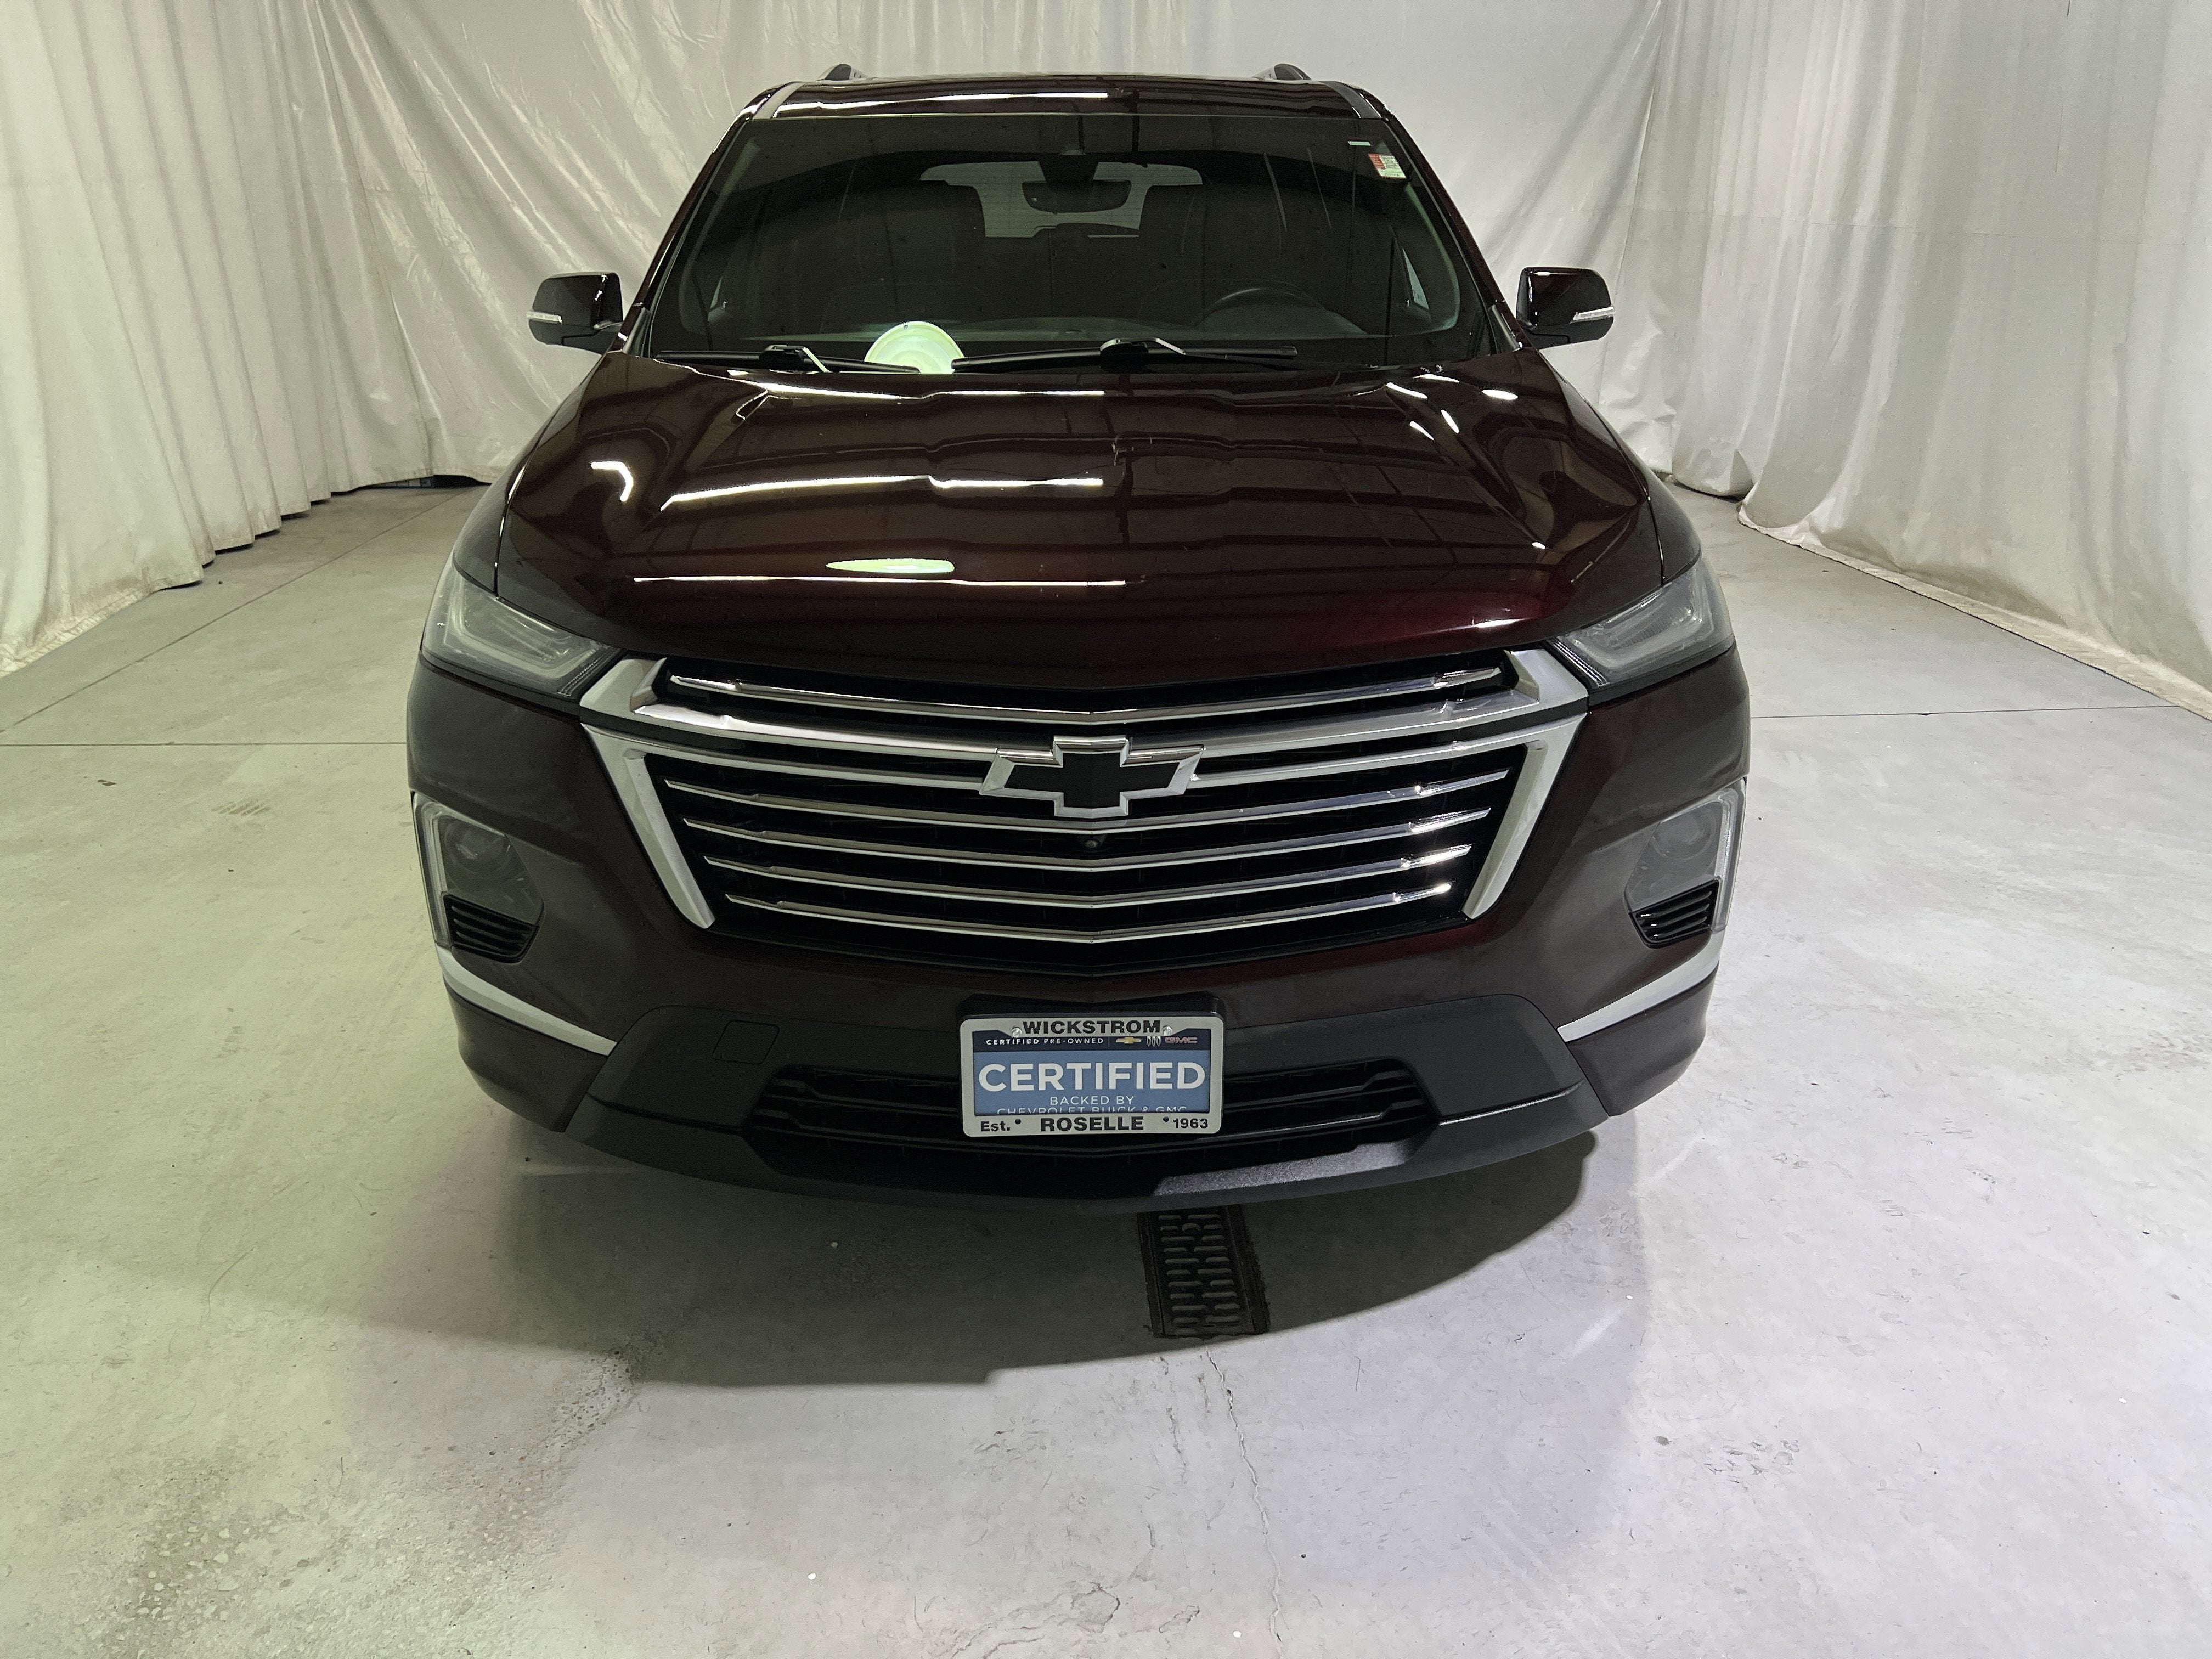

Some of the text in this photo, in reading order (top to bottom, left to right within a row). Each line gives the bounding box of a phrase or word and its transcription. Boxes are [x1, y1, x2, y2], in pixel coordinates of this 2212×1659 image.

[1023, 1020, 1160, 1034] WICKSTROM
[978, 1062, 1205, 1092] CERTIFIED
[1050, 1096, 1134, 1105] BACKED BY
[980, 1116, 1209, 1132] Est. ROSELLE 1963
